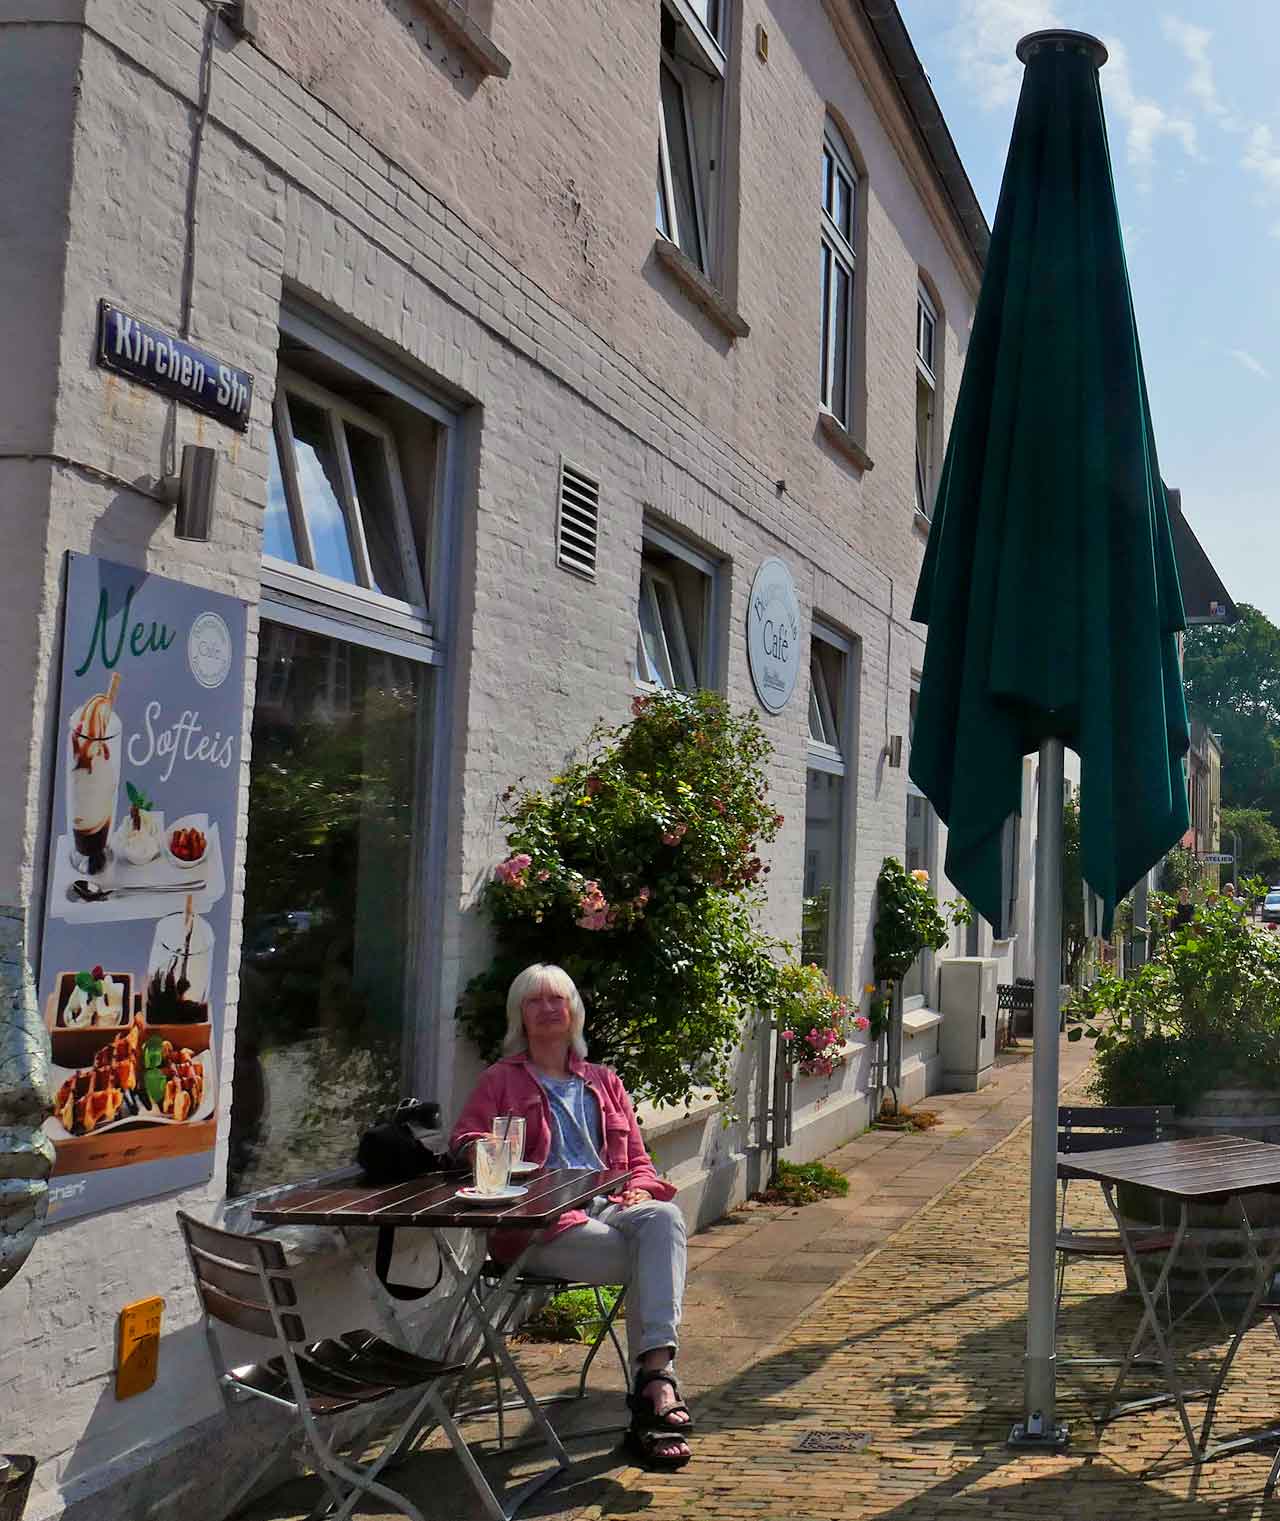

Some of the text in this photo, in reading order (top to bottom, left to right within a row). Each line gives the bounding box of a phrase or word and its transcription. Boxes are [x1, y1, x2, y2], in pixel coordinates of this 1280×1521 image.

[115, 312, 248, 414] Kirchen-Str.
[75, 585, 177, 677] Neu
[763, 619, 789, 663] Café
[127, 701, 233, 782] Softeis
